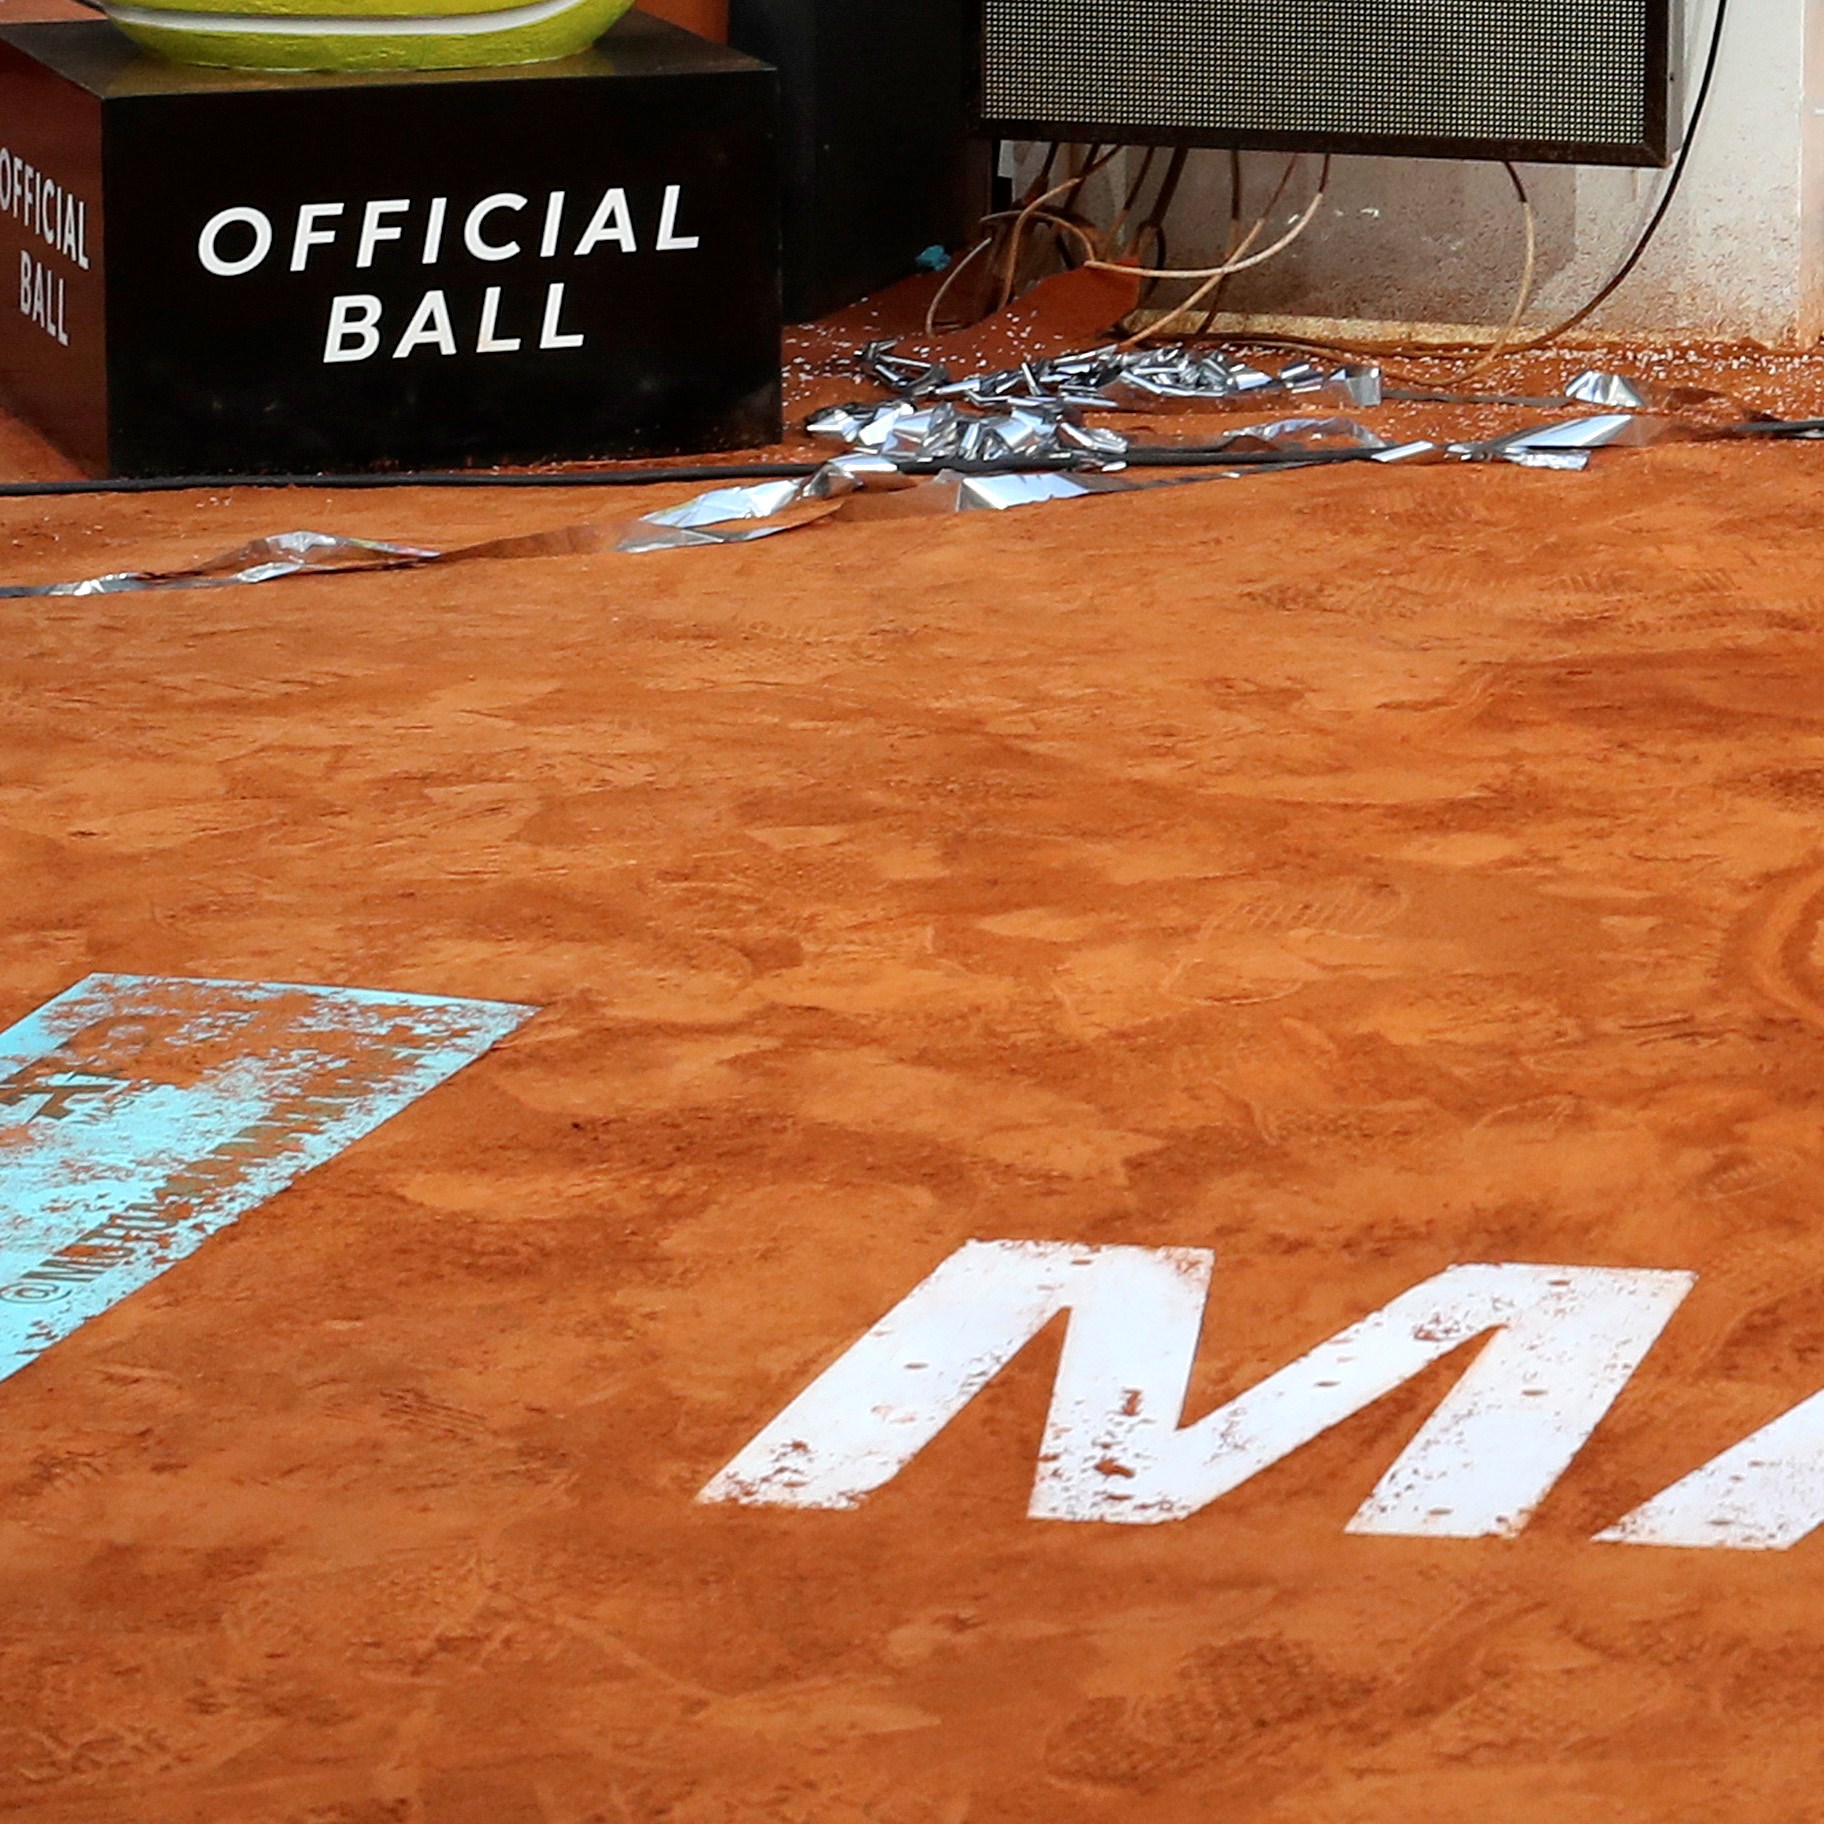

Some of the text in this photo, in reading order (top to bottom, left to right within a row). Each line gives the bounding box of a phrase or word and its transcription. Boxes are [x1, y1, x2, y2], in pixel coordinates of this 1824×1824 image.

[0, 147, 89, 270] OFFICIAL
[198, 184, 699, 276] OFFICIAL
[20, 249, 69, 347] BALL
[323, 282, 584, 363] BALL
